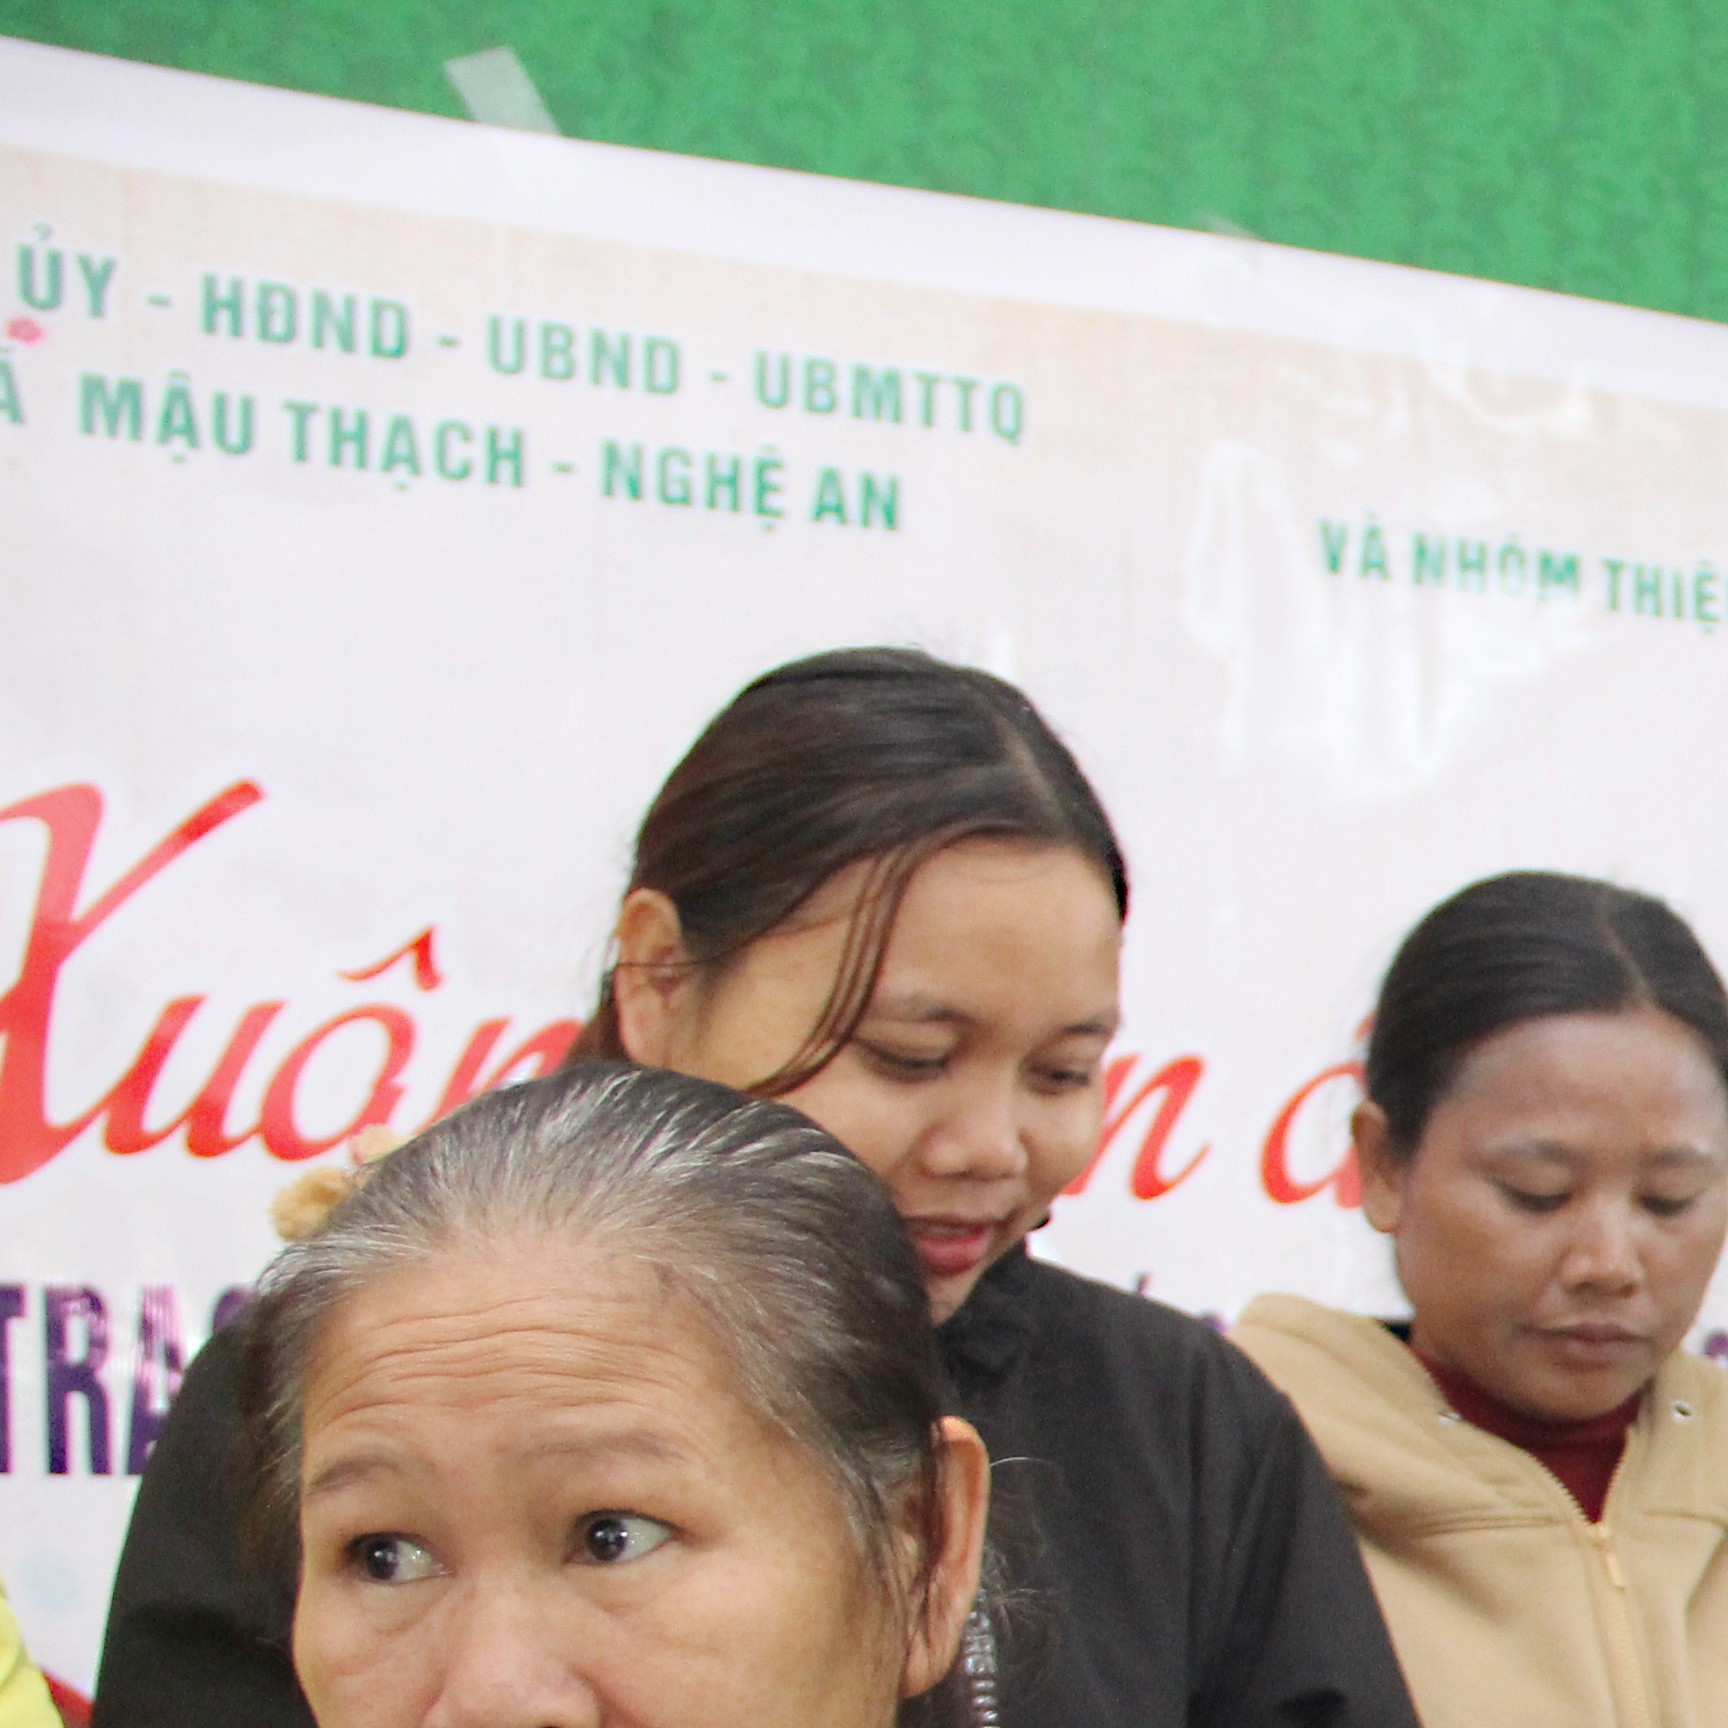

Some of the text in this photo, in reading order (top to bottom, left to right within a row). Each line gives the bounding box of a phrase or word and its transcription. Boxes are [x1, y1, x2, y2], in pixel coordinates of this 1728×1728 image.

[16, 222, 118, 319] ỦY
[201, 272, 410, 360] HĐND
[487, 313, 681, 395] UBND
[754, 349, 1025, 445] UBMTTQ
[78, 369, 255, 465] MẬU
[282, 399, 525, 490] THẠCH
[602, 443, 785, 534] NGHỆ
[811, 466, 900, 532] AN
[1318, 511, 1391, 582] VÀ
